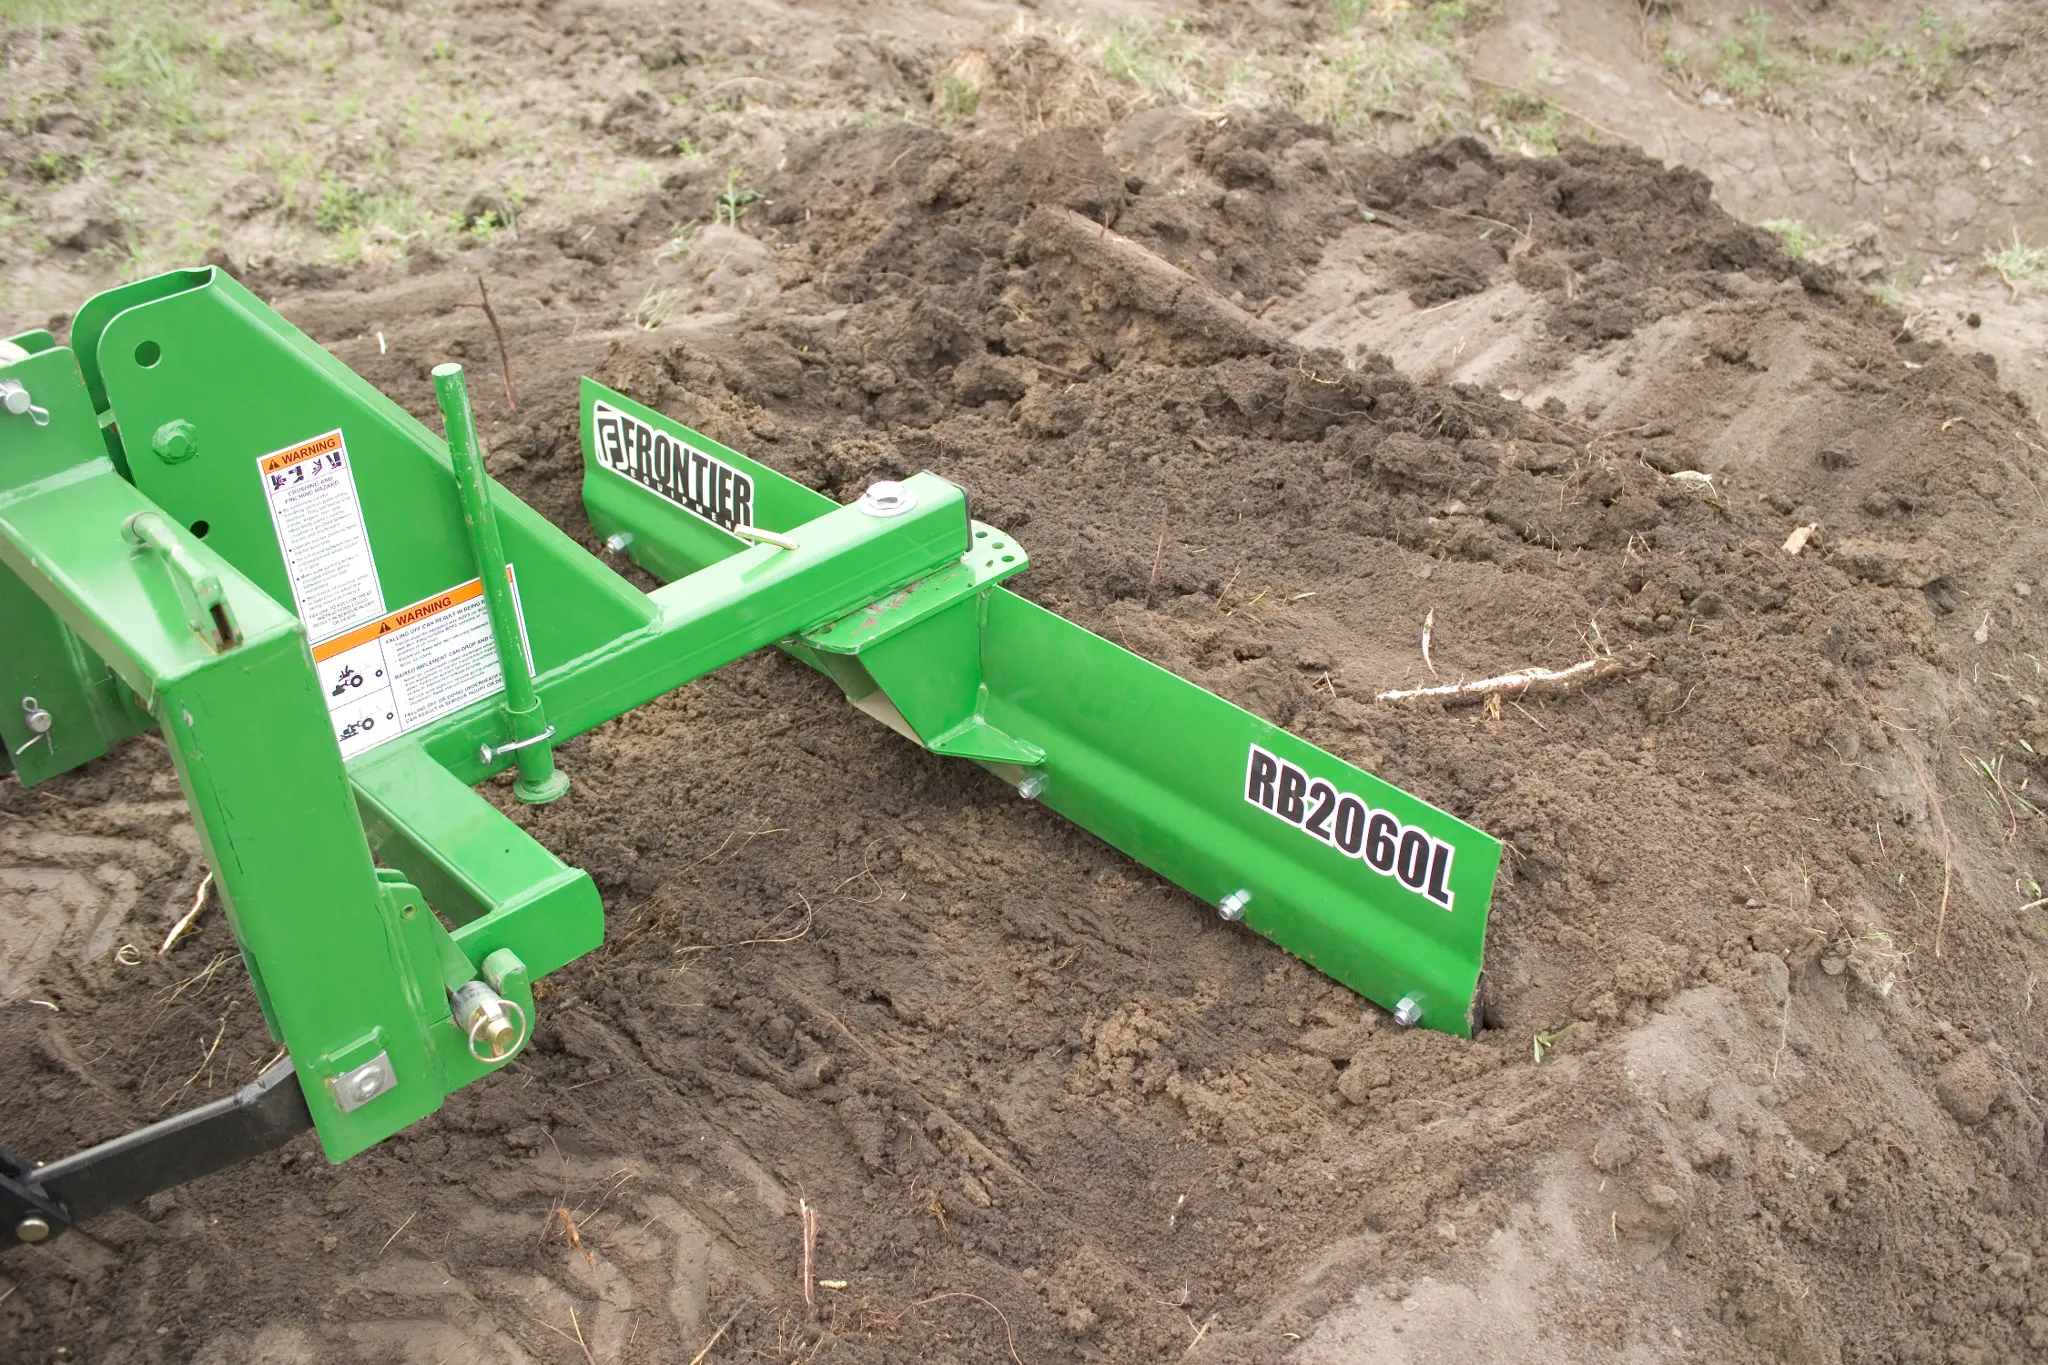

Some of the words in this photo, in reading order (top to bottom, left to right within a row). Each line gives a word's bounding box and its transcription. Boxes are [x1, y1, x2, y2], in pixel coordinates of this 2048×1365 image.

[281, 437, 336, 466] WARNING
[287, 480, 319, 496] CRUSHING
[319, 475, 333, 484] AND
[620, 416, 751, 527] FRONTIER
[630, 468, 733, 530] EQUIPMEN
[396, 597, 452, 626] WARNING
[385, 630, 409, 645] FALLING
[409, 625, 421, 634] OFF
[421, 620, 434, 629] CAN
[394, 666, 415, 680] RAISED
[415, 652, 447, 671] IMPLEMENT
[448, 647, 460, 657] CAN
[476, 635, 488, 644] AND
[1248, 748, 1450, 906] RB2060L
